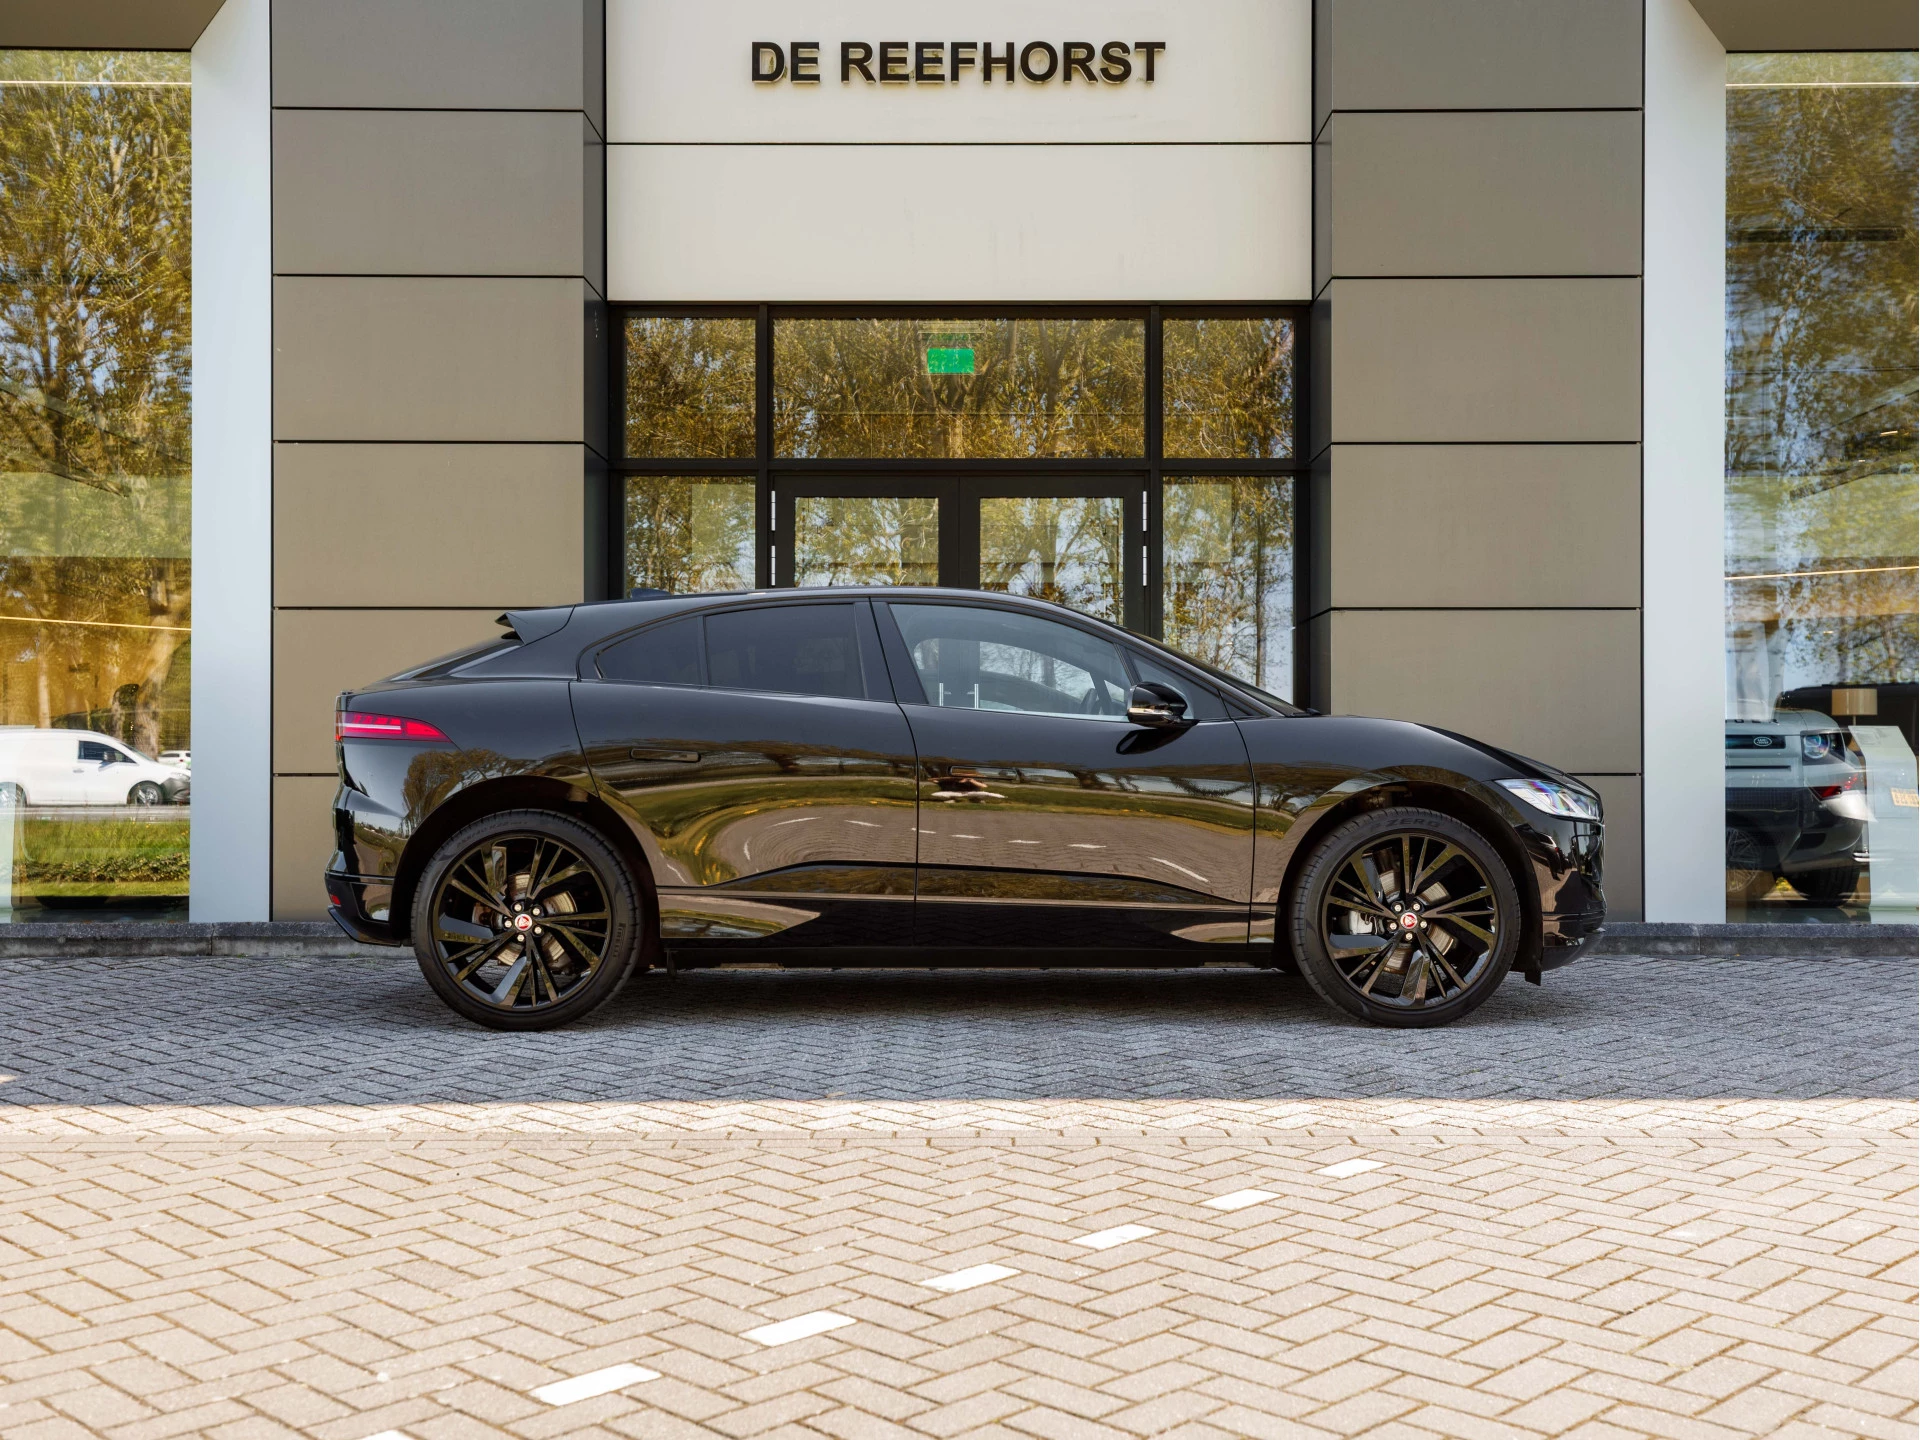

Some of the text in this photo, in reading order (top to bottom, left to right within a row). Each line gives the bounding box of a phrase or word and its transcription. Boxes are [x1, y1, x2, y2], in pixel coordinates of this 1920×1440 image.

[752, 41, 1166, 84] DE REEFHORST
[1385, 817, 1440, 828] ZERO
